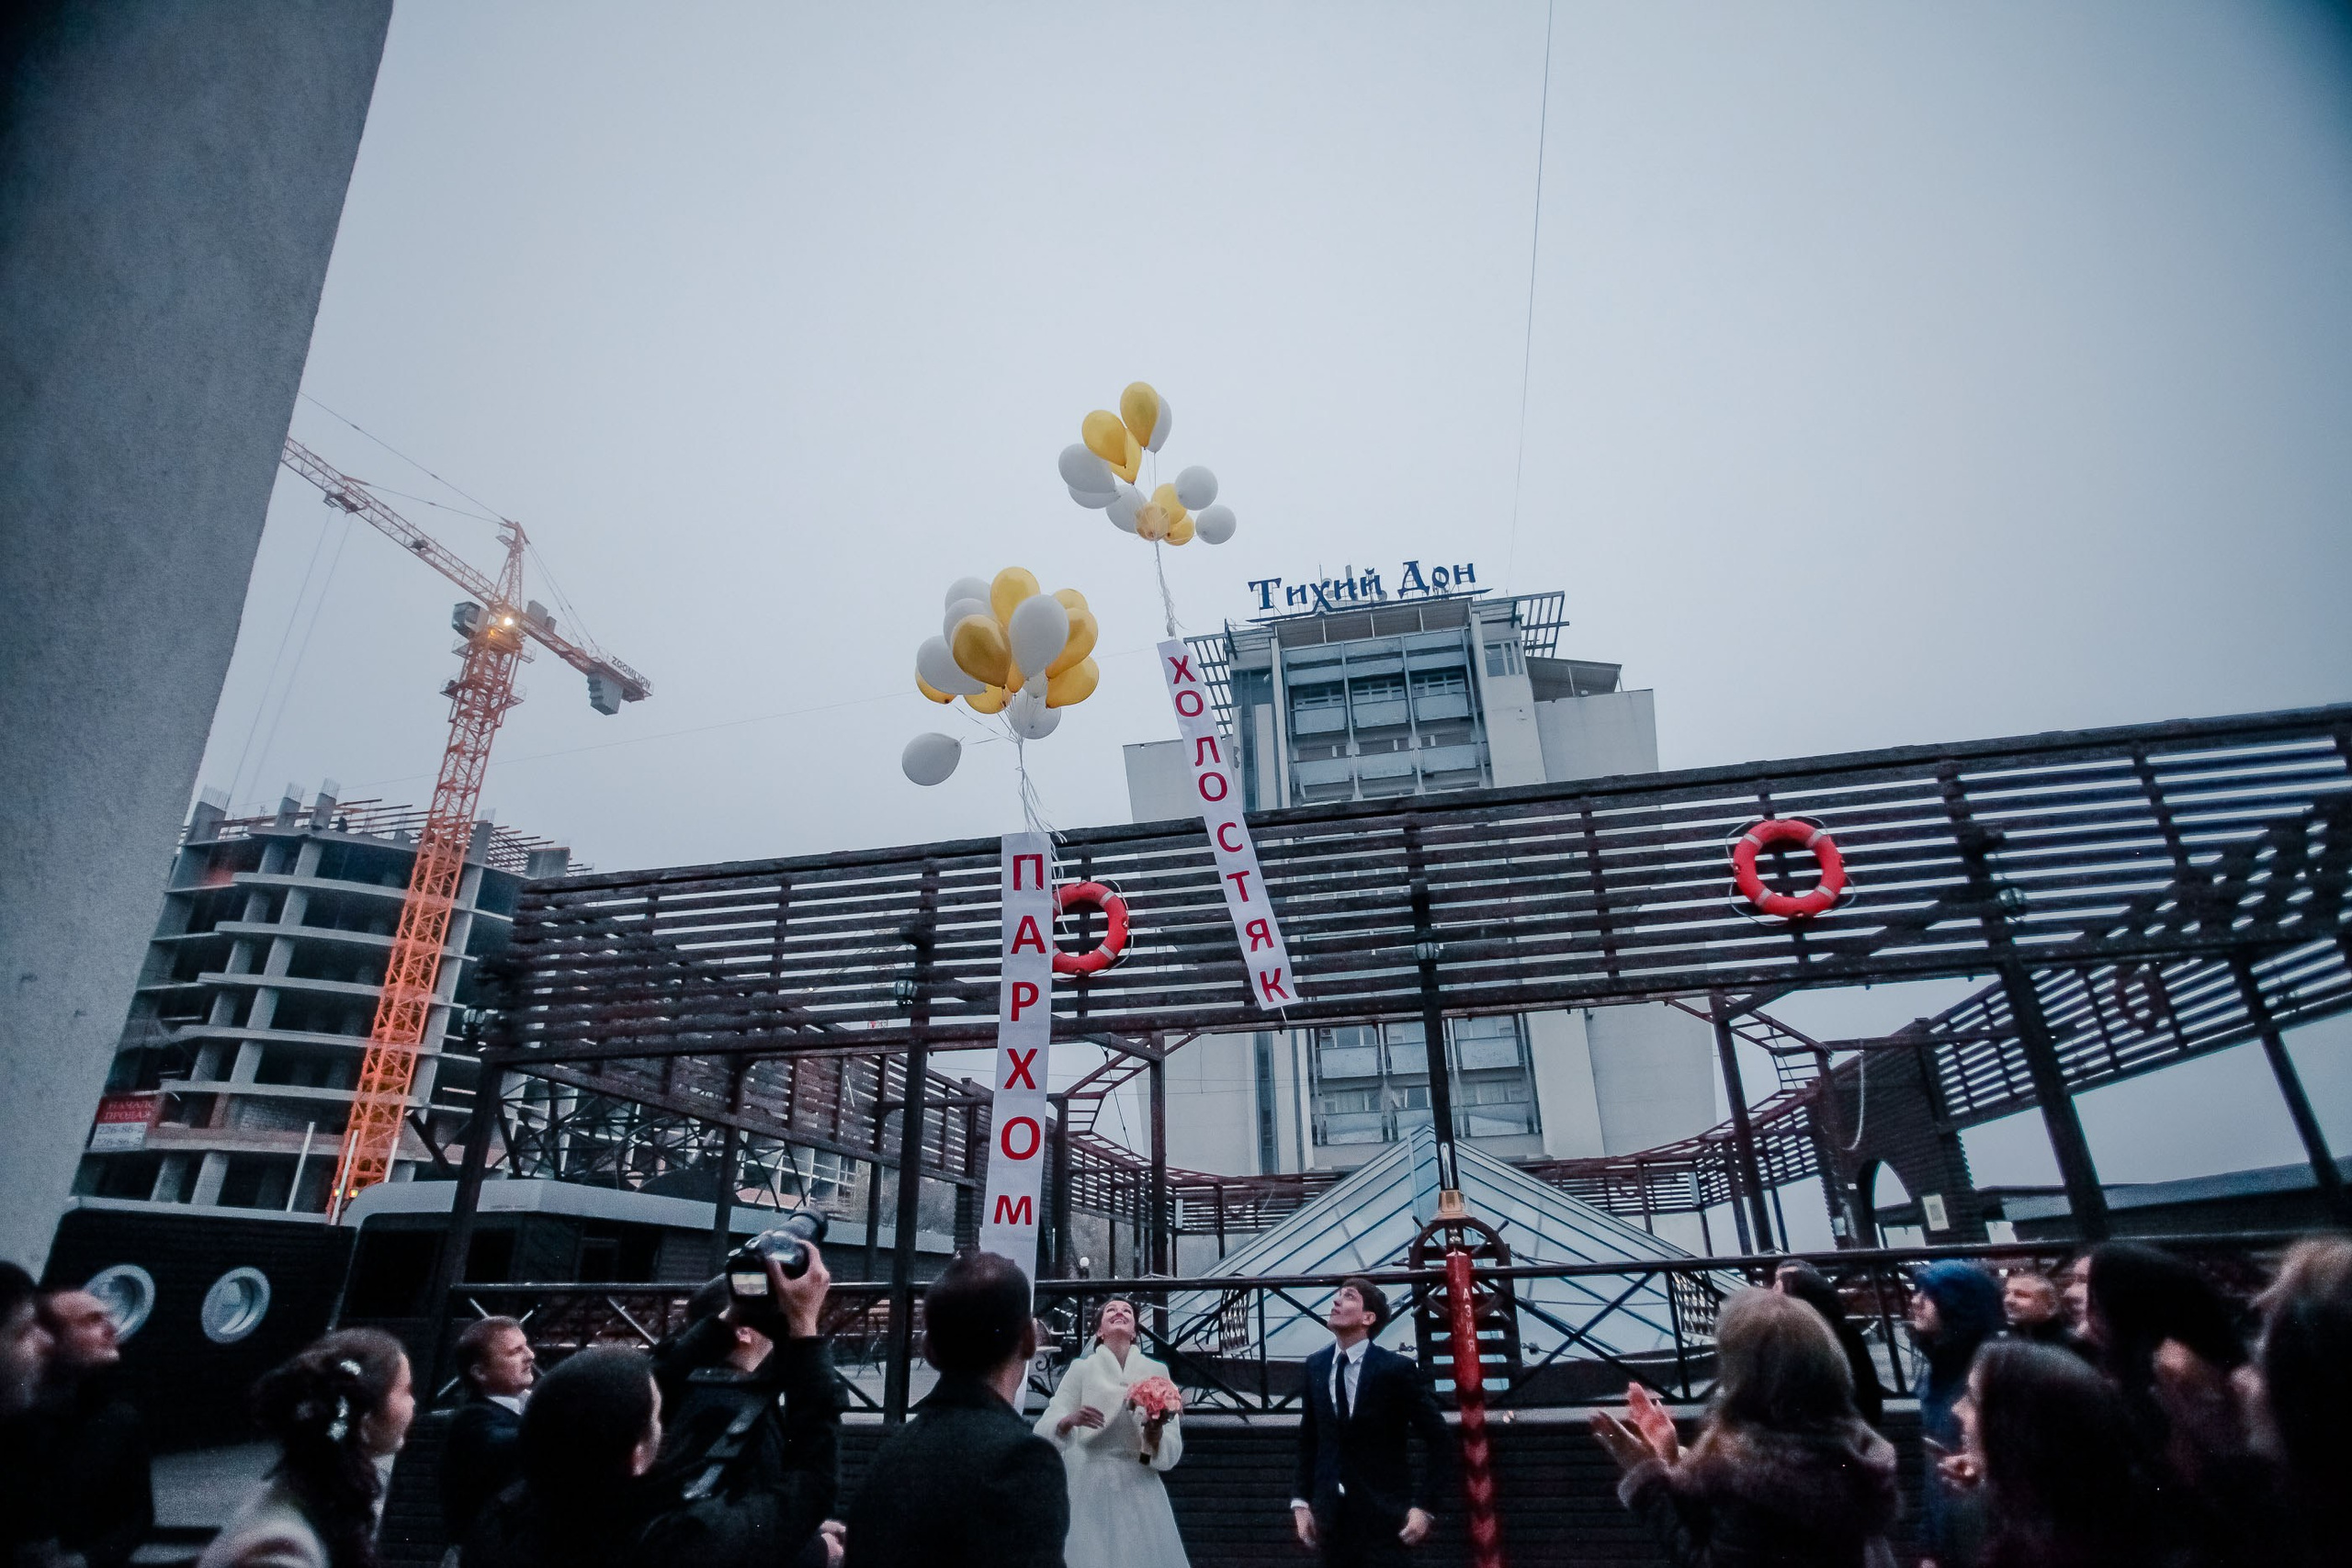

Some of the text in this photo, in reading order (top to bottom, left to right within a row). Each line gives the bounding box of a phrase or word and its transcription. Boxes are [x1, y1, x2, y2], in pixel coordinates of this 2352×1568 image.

[1248, 560, 1476, 613] Тихий Дон
[611, 655, 651, 690] ZOOMLION
[1167, 655, 1290, 1003] ХОЛОСТЯК
